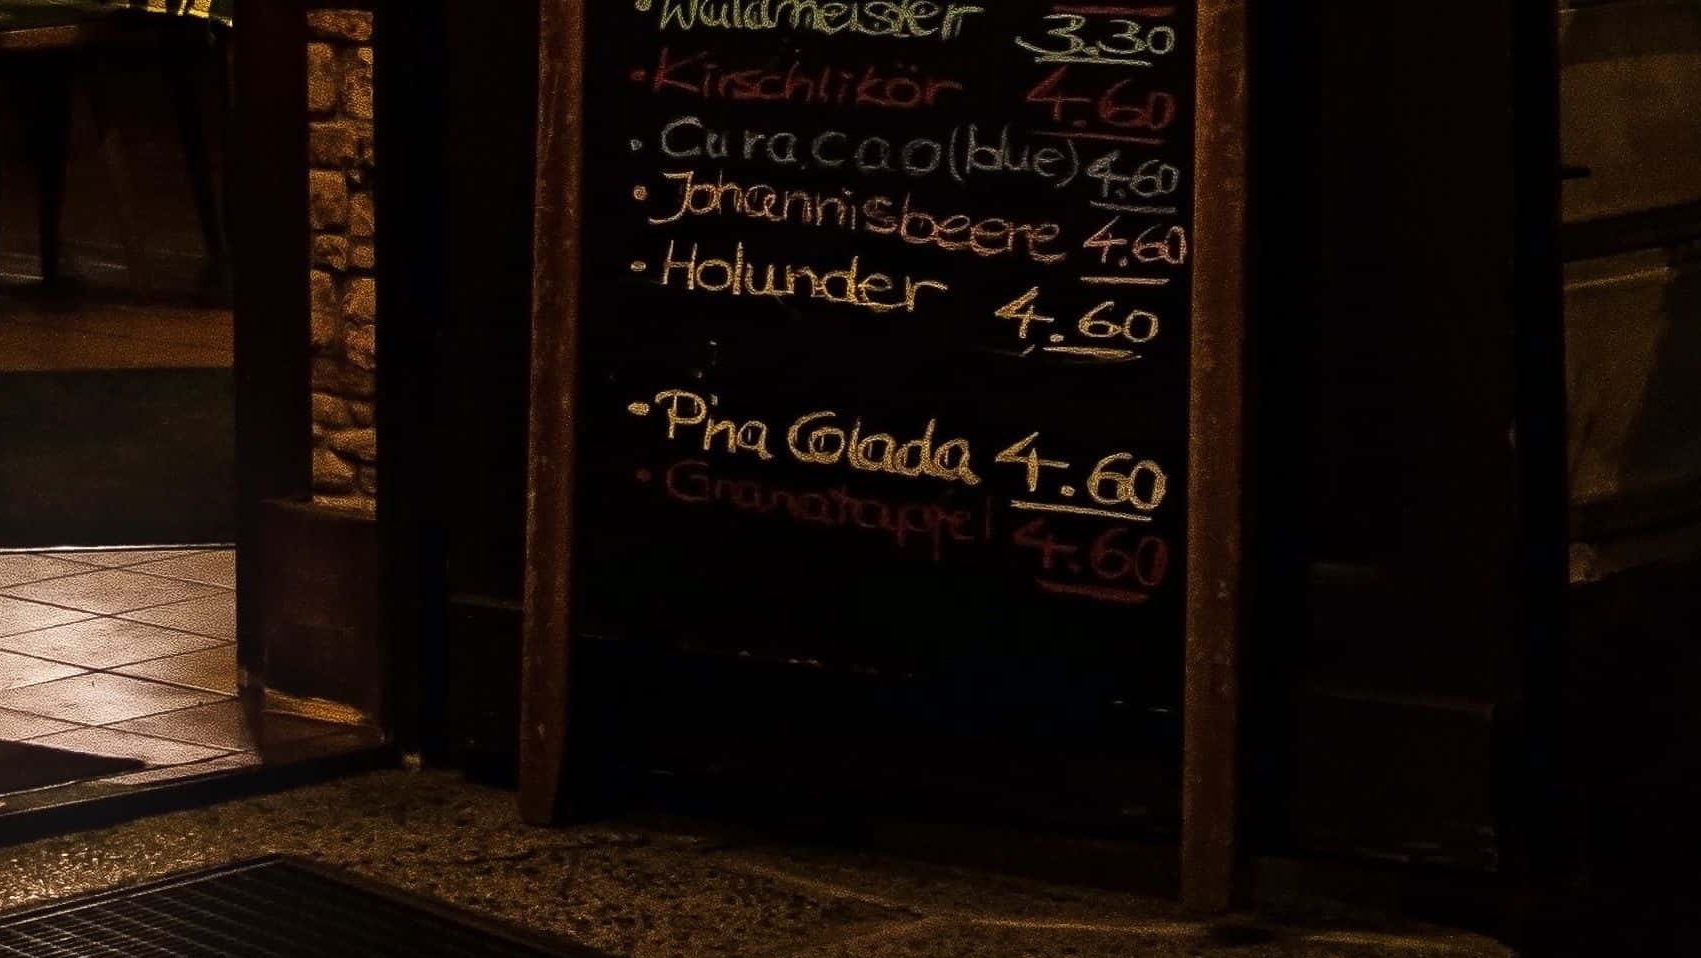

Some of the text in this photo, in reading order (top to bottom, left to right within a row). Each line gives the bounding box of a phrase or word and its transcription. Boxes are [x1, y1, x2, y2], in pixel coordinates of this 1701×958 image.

[1014, 13, 1176, 56] 3.30
[651, 46, 1176, 130] Kirschlikör 4.60
[1084, 150, 1180, 199] 4.60
[648, 168, 1188, 267] Johannisbeere 4.60
[660, 239, 1161, 344] Holunder 4.60
[786, 410, 983, 488] Colada
[994, 431, 1168, 511] 4.60
[1011, 516, 1171, 588] 4.60
